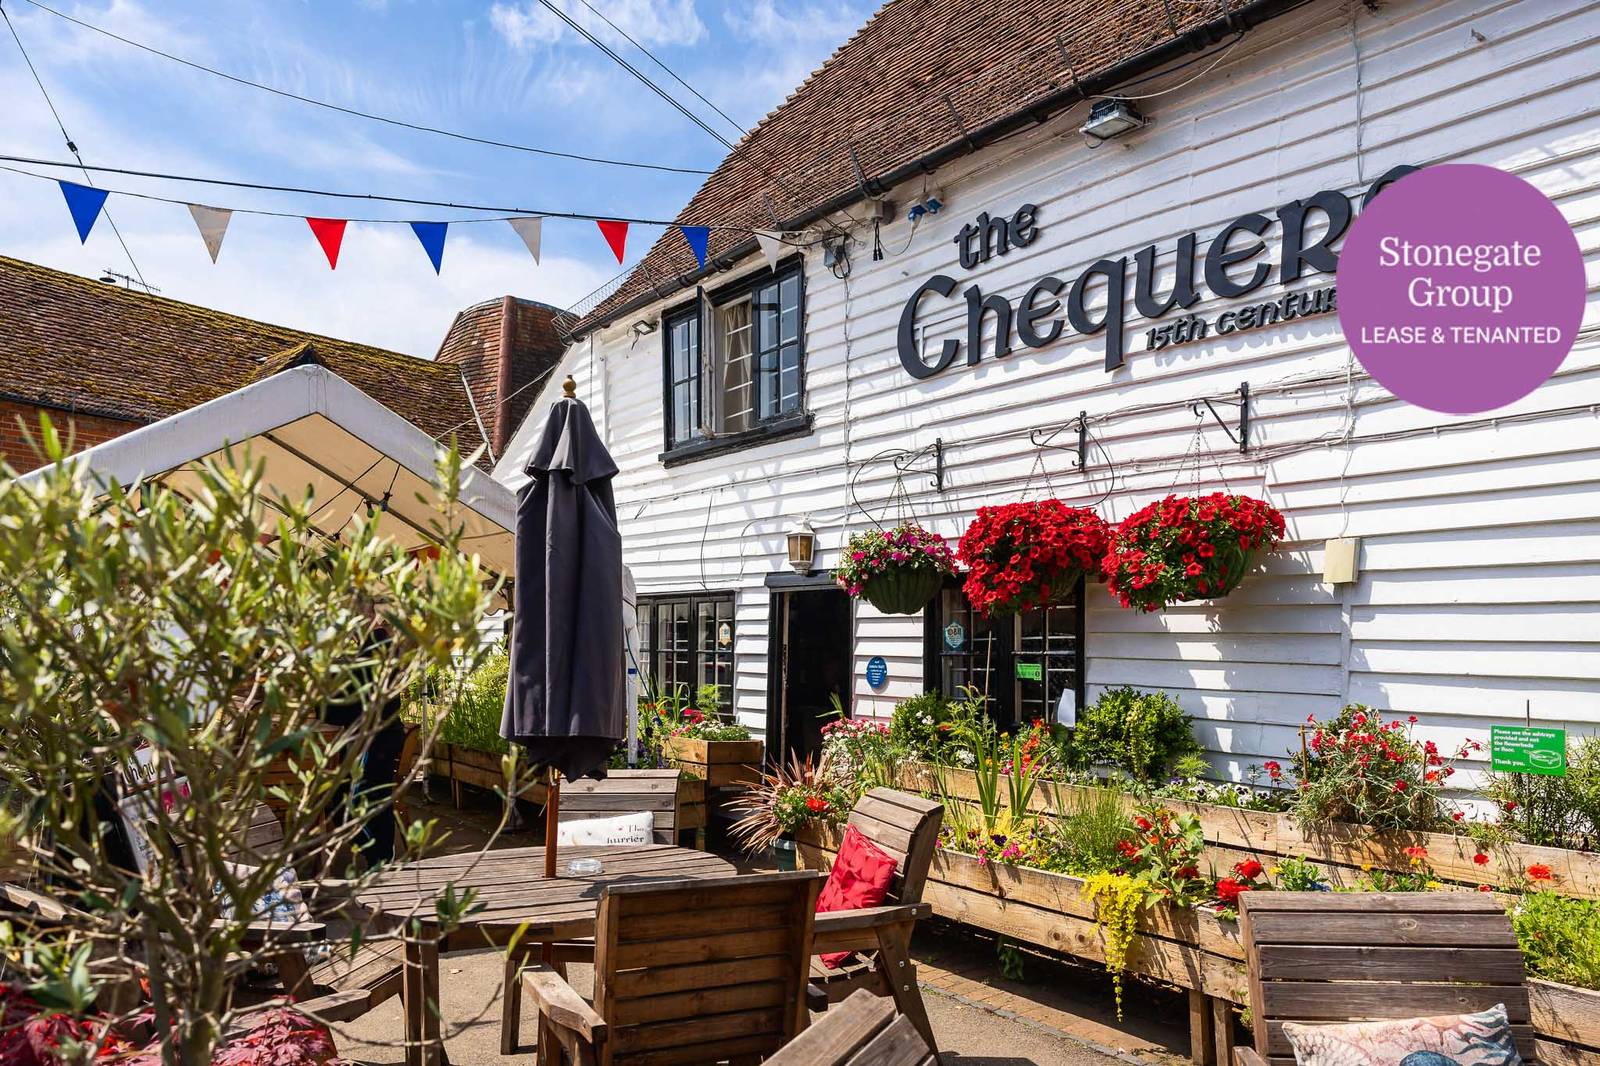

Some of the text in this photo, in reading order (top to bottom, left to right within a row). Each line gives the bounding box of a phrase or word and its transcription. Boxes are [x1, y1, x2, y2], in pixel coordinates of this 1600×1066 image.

[954, 203, 1039, 269] the
[897, 164, 1422, 379] Chequer
[1145, 286, 1338, 351] 15th centur
